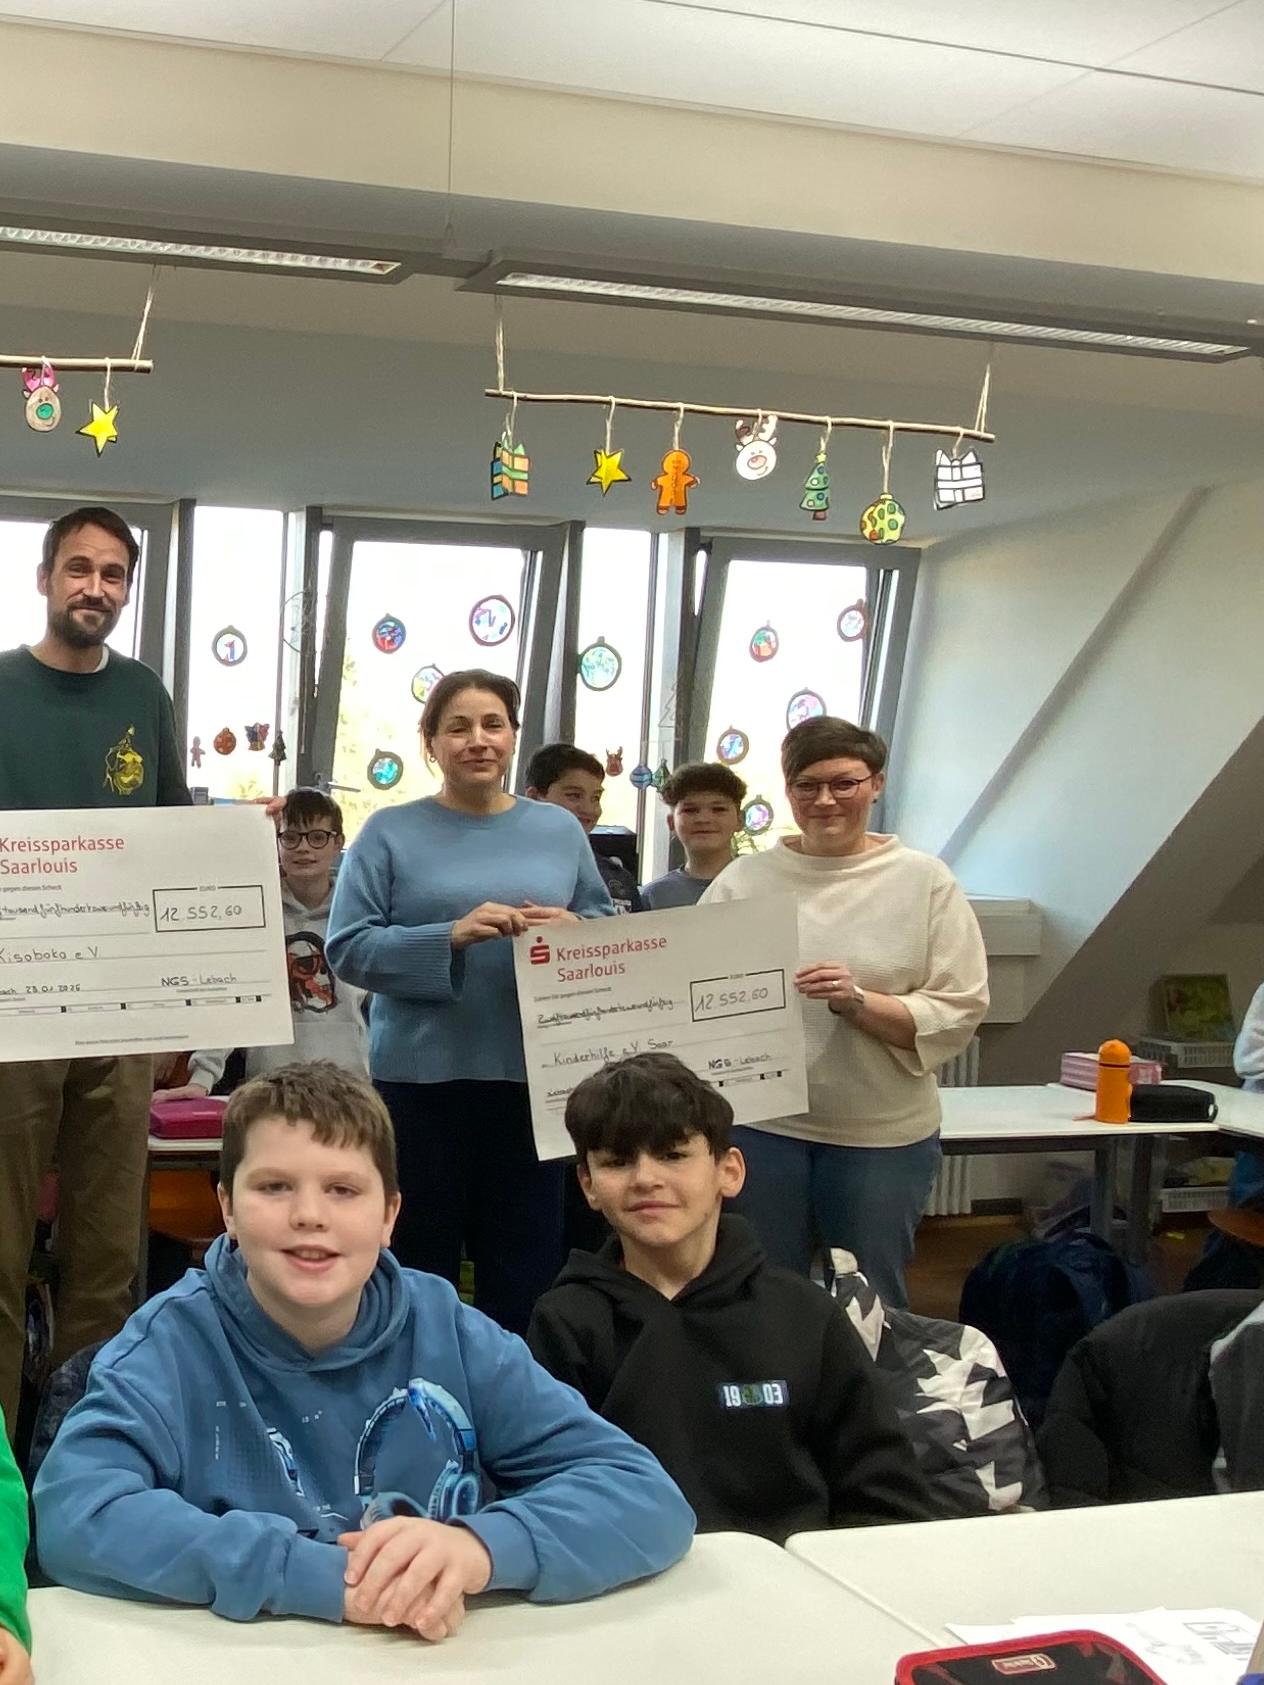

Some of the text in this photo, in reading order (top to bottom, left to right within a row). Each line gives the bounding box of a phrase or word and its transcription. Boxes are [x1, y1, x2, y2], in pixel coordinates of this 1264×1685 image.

[0, 857, 78, 875] Saarlouis
[556, 937, 668, 962] Kreissparkasse
[557, 961, 626, 982] Saarlouis
[161, 976, 190, 987] NGS
[554, 1047, 616, 1066] Kinderhilfe
